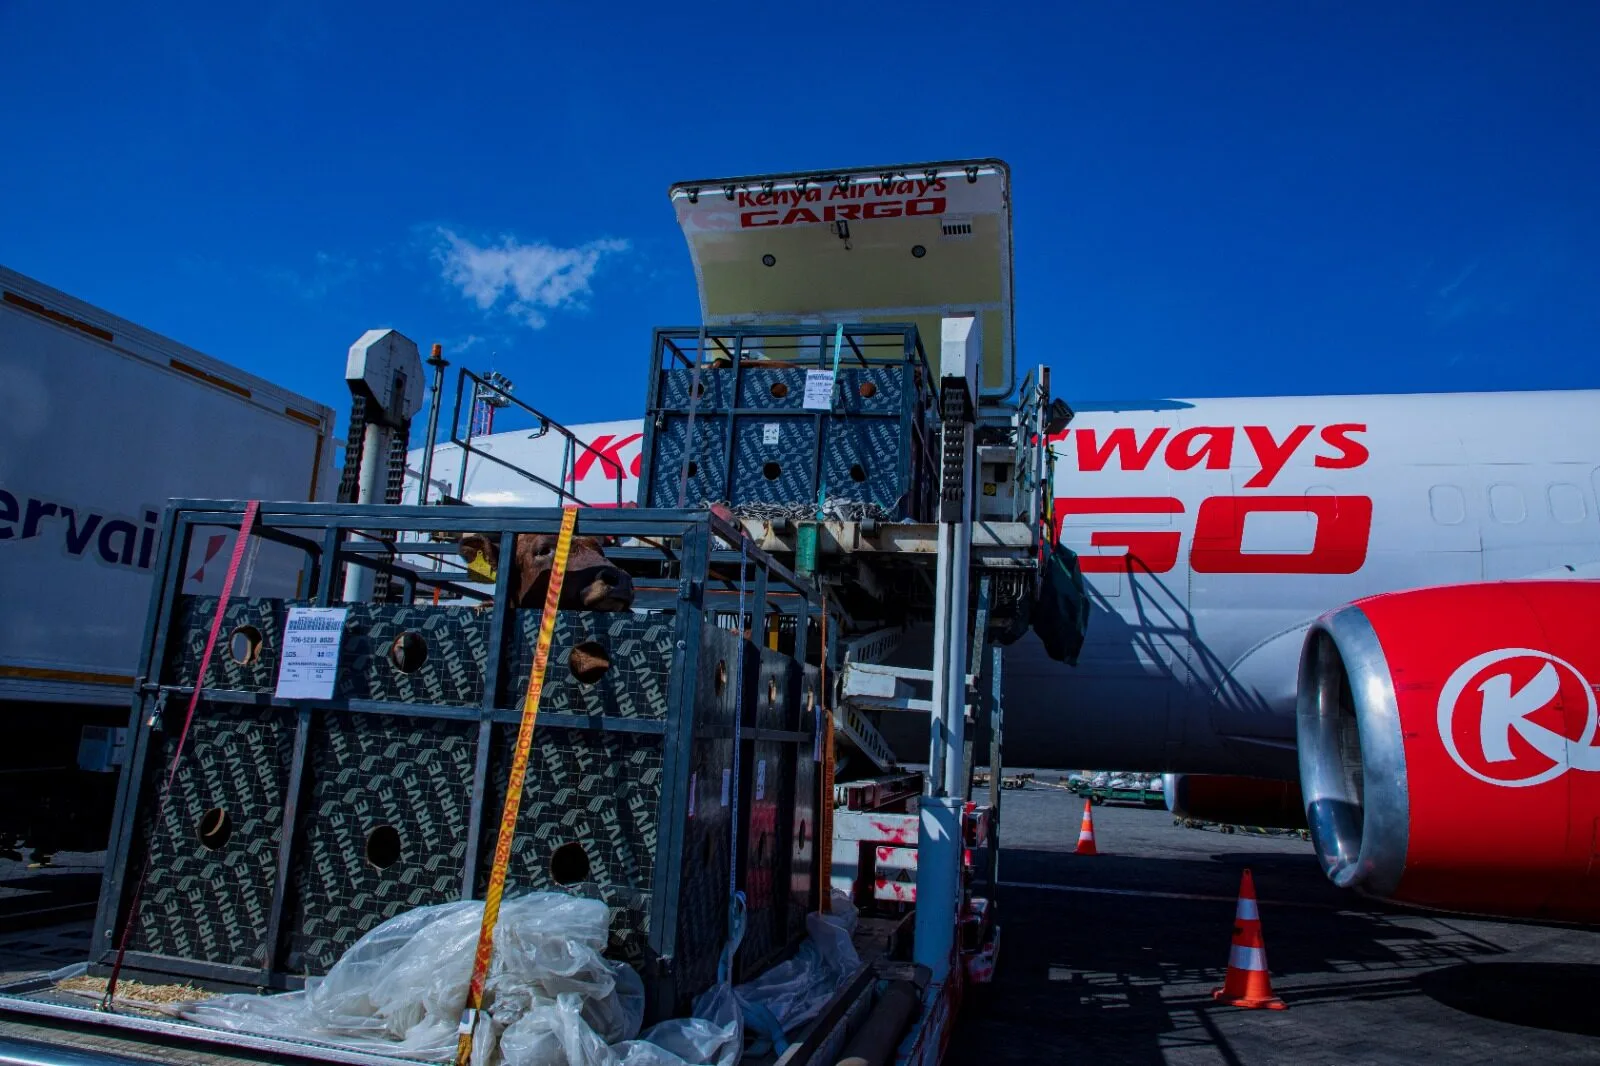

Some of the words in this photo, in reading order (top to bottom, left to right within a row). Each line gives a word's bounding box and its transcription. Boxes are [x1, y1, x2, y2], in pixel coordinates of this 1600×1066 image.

[738, 187, 823, 207] Kenya
[828, 177, 946, 201] Airways
[740, 197, 947, 228] CARGO
[830, 444, 849, 476] THRIVE
[841, 438, 859, 463] THRIV
[879, 424, 897, 451] HRIVE
[434, 625, 472, 700] THRIVE
[459, 612, 488, 683] HRIVE
[630, 651, 668, 721] HRIVE
[223, 742, 256, 816] THRIVE
[247, 729, 279, 804] THRIVE
[427, 760, 465, 839] THRIVE
[402, 774, 440, 852] THRIVE
[306, 824, 340, 903] THRIVE
[329, 812, 365, 890] THRIVE
[574, 821, 617, 902] THRIVE
[164, 899, 193, 959] HRIVE
[187, 887, 220, 961] THRIVE
[211, 874, 244, 952] THRIVE
[234, 862, 268, 940] THRIVE
